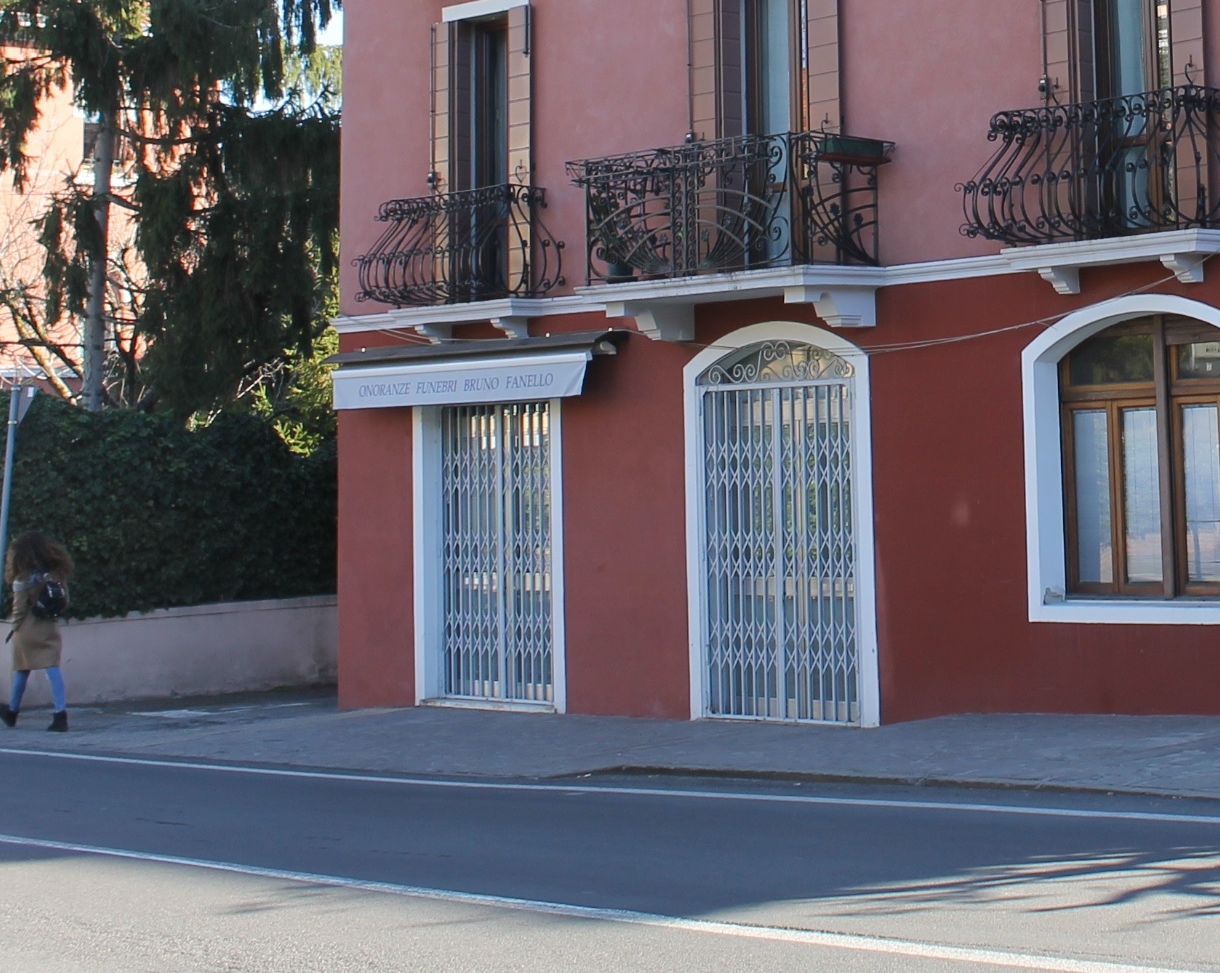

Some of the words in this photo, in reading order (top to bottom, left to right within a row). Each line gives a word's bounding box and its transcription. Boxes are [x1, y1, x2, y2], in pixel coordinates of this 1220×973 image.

[359, 382, 411, 397] ONORANZE
[416, 380, 457, 394] FUNEBRI
[464, 377, 500, 391] BRUNO
[506, 373, 554, 389] FANELLO
